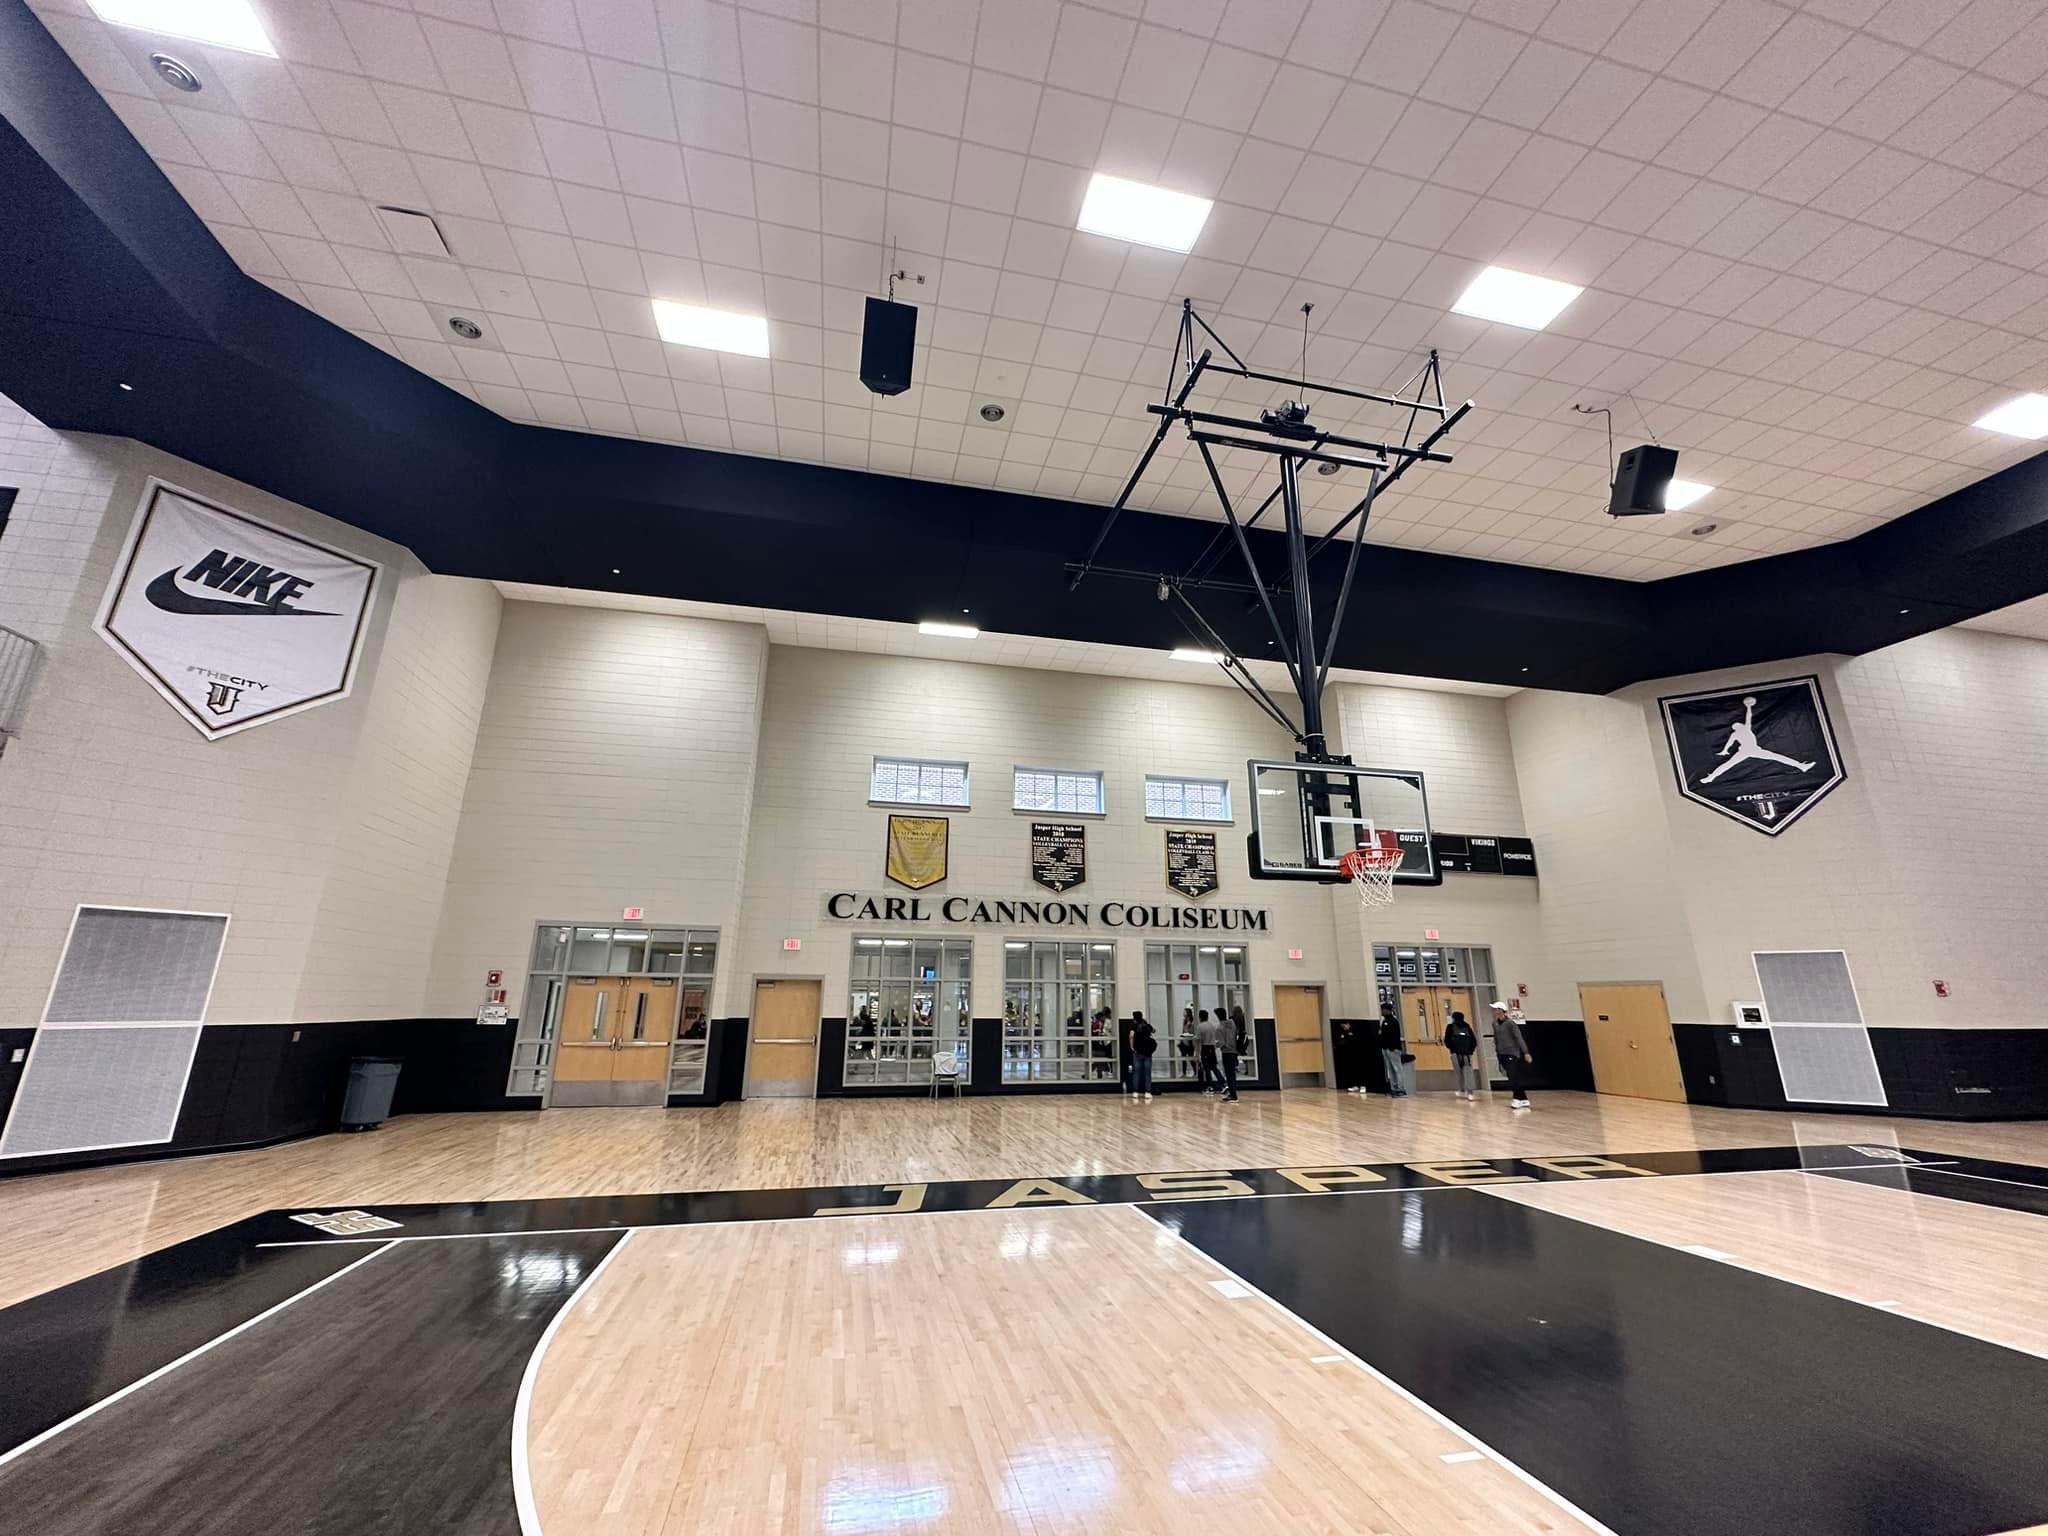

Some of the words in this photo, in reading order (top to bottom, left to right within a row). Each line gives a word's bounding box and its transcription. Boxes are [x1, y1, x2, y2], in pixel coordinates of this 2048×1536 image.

[183, 548, 315, 610] NIKE
[186, 665, 269, 691] #THECITY
[827, 893, 931, 921] CARL
[943, 897, 1090, 925] CANNON
[1100, 902, 1268, 931] COLISEUM
[813, 1156, 1661, 1217] JASPER
